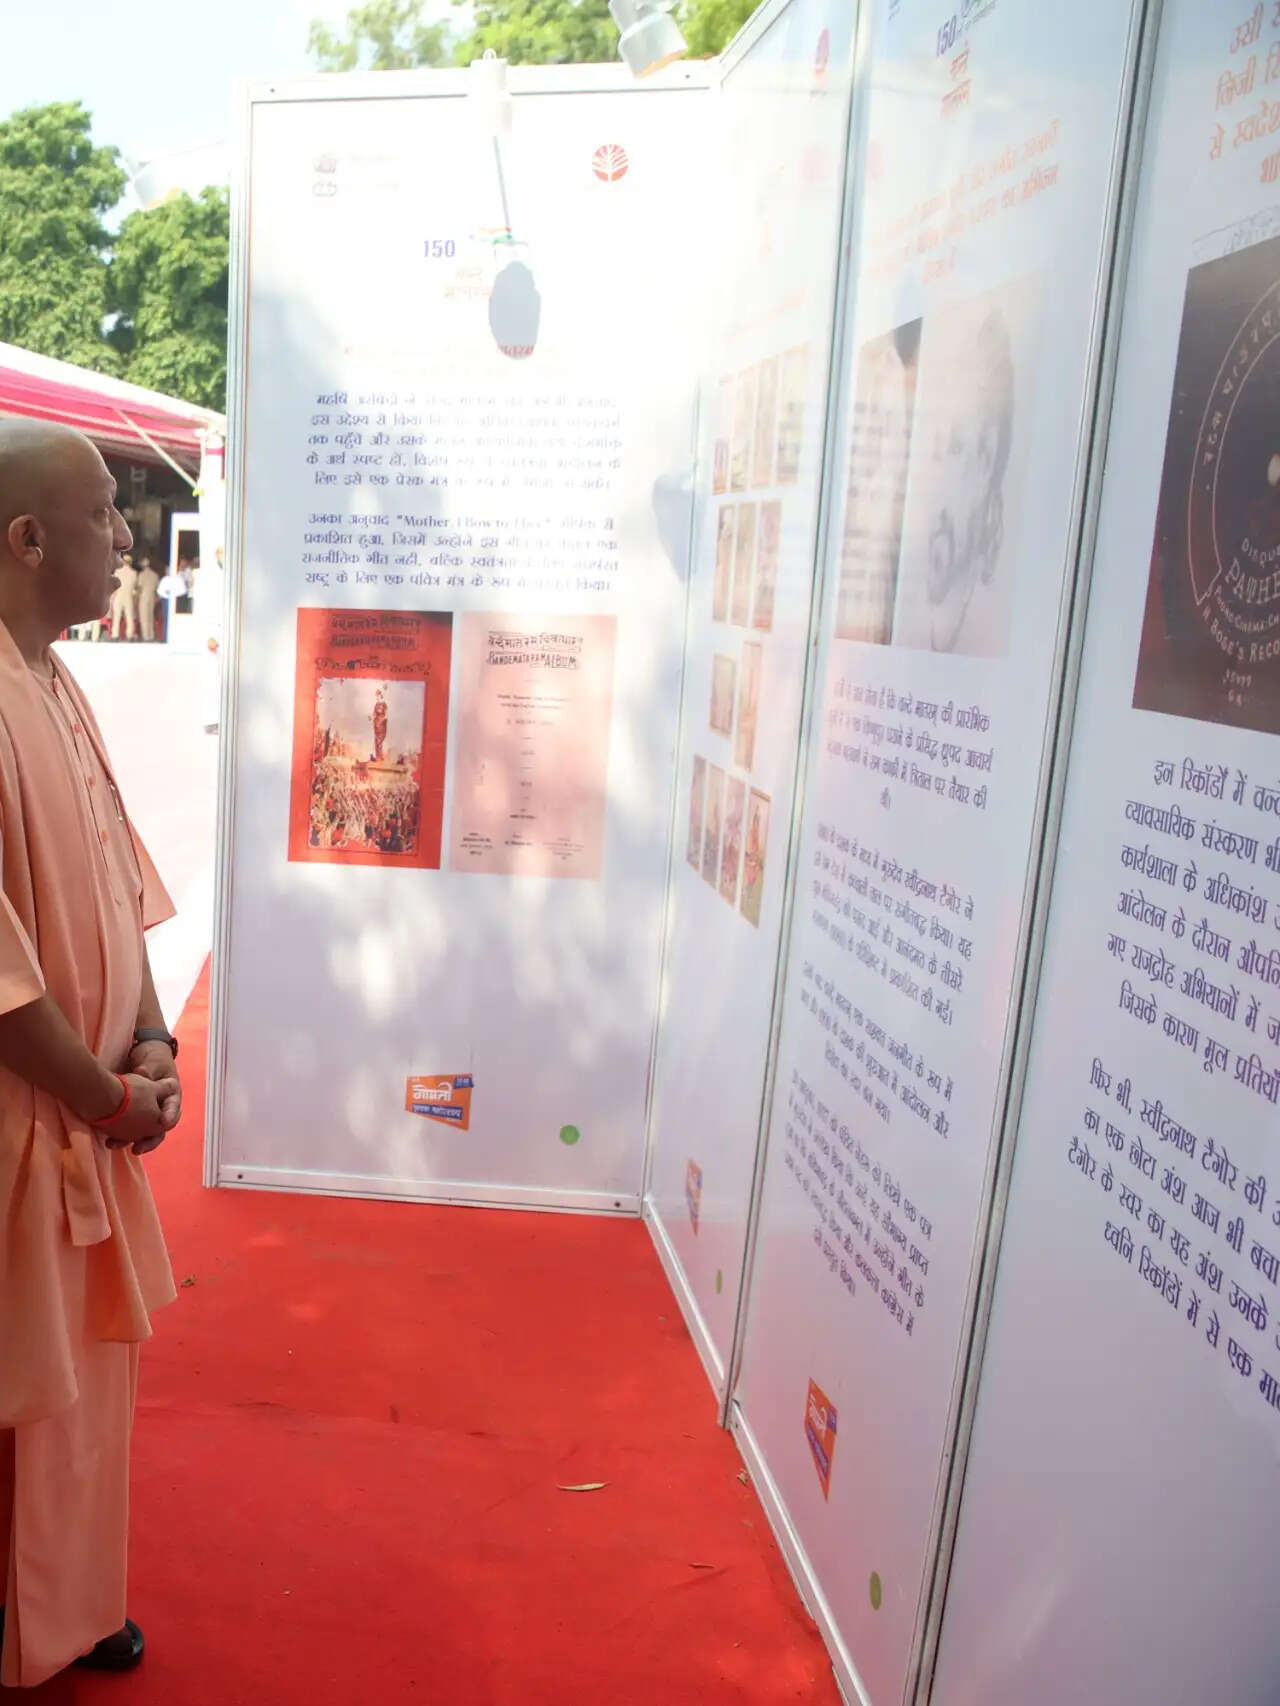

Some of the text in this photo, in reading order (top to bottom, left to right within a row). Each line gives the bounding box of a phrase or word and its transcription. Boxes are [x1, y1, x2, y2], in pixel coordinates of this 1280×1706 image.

[423, 240, 456, 258] 150
[307, 450, 319, 464] के
[369, 473, 390, 486] एक
[336, 571, 348, 584] के
[384, 574, 405, 586] एक
[1154, 760, 1175, 786] इन
[1232, 768, 1249, 806] में
[1125, 799, 1196, 841] व्यावसायिक
[1201, 818, 1260, 864] संस्करण
[1121, 843, 1178, 886] कार्यशाला
[1183, 859, 1198, 893] के
[1203, 871, 1269, 924] अधिकांश
[1117, 888, 1167, 932] आंदोलन
[1172, 905, 1186, 939] के
[1191, 917, 1232, 963] दौरान
[1107, 932, 1126, 963] गए
[1131, 944, 1175, 989] राजद्रोह
[1180, 967, 1241, 1022] अभियानों
[1245, 994, 1262, 1033] में
[1118, 979, 1280, 1105] जिसके कारण मूल प्रतियाँ
[1090, 1057, 1112, 1096] फिर
[1116, 1077, 1132, 1115] भी,
[1201, 1136, 1239, 1191] टैगोर
[1244, 1175, 1266, 1213] की
[1084, 1106, 1101, 1136] का
[1105, 1121, 1125, 1152] एक
[1129, 1135, 1157, 1180] छोटा
[1161, 1165, 1187, 1206] अंश
[1191, 1192, 1221, 1235] आज
[1226, 1216, 1244, 1254] भी
[1068, 1135, 1269, 1331] टैगोर के स्वर का यह अंश उनके
[1104, 1220, 1134, 1264] ध्वनि
[1187, 1288, 1202, 1329] में
[1207, 1309, 1221, 1349] से
[1227, 1336, 1254, 1377] एक
